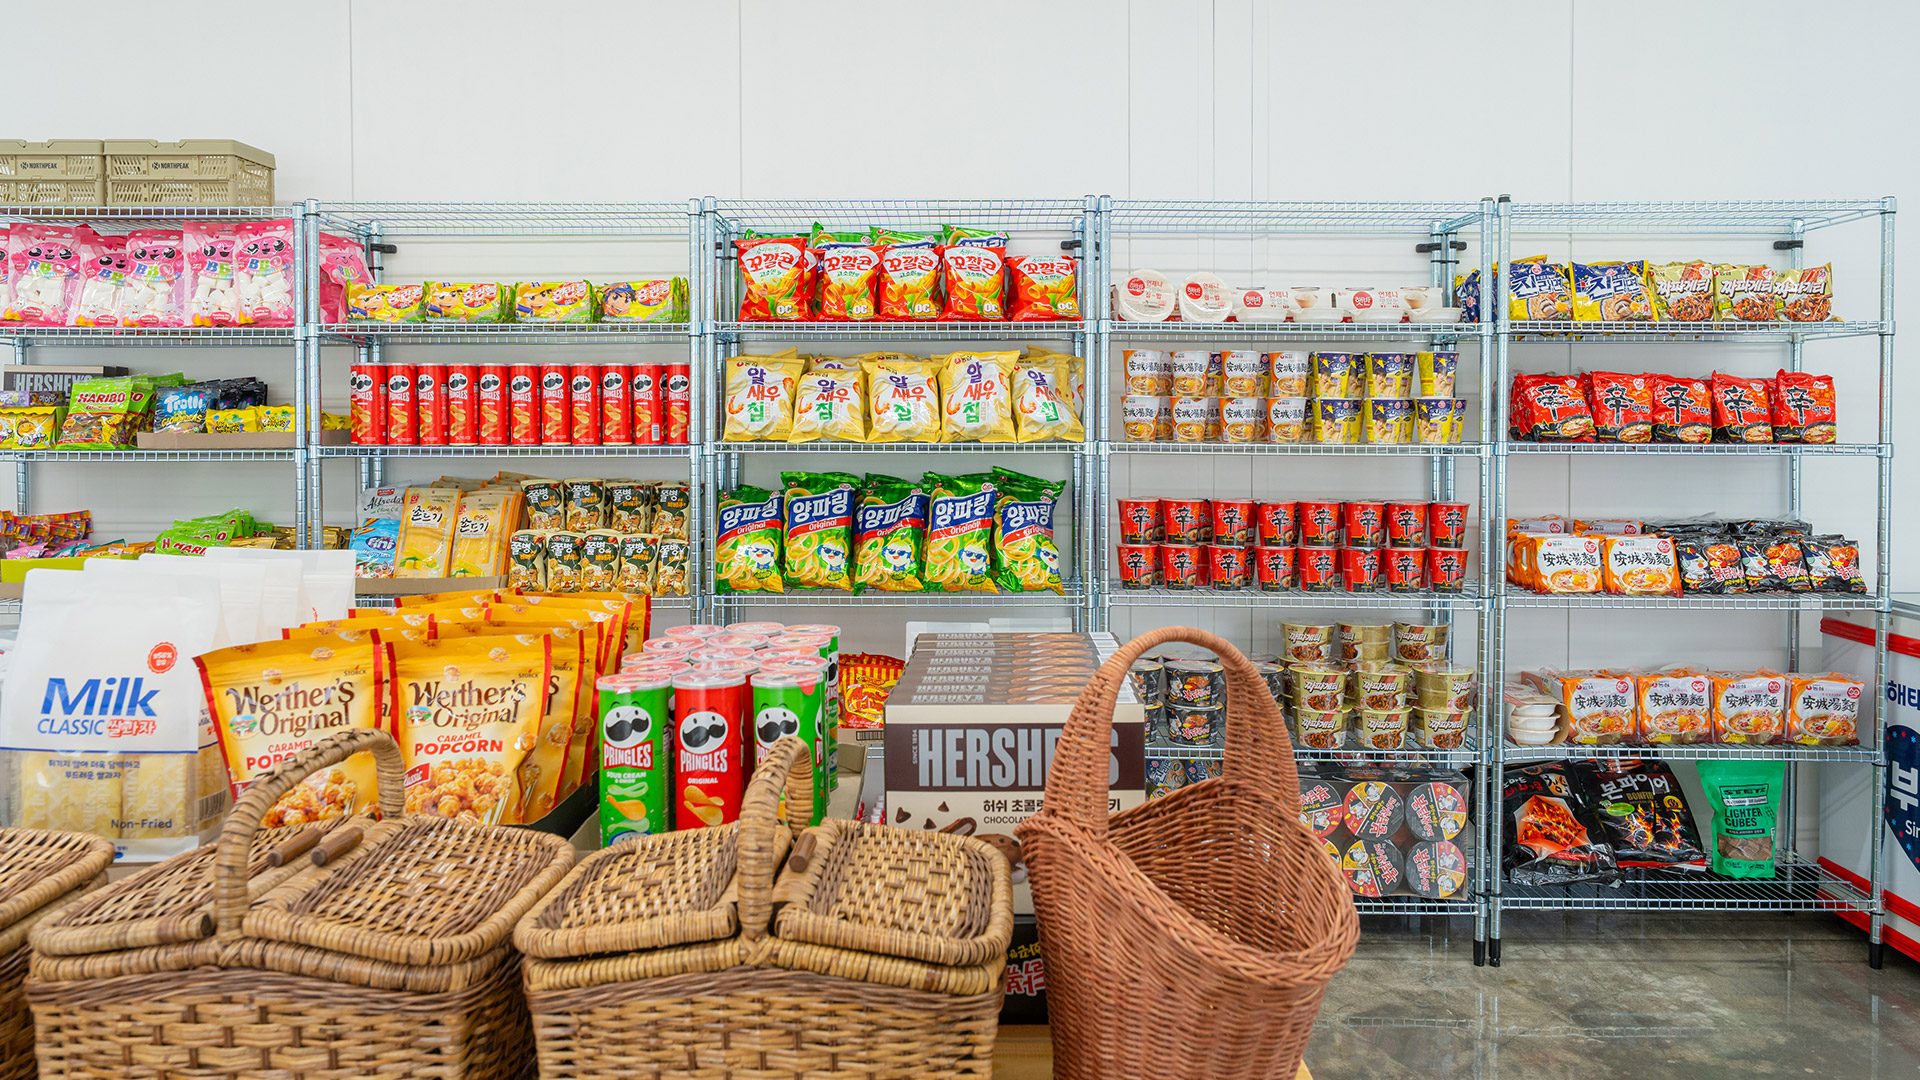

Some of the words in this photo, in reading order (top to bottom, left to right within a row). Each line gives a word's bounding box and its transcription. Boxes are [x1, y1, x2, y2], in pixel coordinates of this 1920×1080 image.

[745, 251, 795, 272] 꼬깔콘
[825, 255, 873, 272] 꼬깔콘
[884, 255, 934, 272] 꼬깔콘
[949, 255, 999, 276] 꼬깔콘
[1023, 261, 1071, 276] 꼬깔콘
[1511, 275, 1563, 299] 진라면
[1586, 275, 1641, 302] 진라면
[1656, 279, 1711, 299] 짜파게티
[1720, 279, 1774, 299] 짜파게티
[1774, 280, 1827, 299] 짜파게티
[1245, 295, 1262, 305] 햇반
[1354, 296, 1371, 306] 햇반
[747, 367, 767, 385] 알
[889, 375, 908, 389] 알
[966, 362, 983, 384] 알
[1027, 370, 1048, 386] 알
[746, 384, 780, 402] 새우
[815, 388, 850, 403] 새우
[817, 379, 837, 393] 알
[891, 386, 927, 402] 새우
[963, 380, 997, 401] 새우
[77, 391, 126, 404] HARIBO
[164, 393, 203, 413] Trolli
[1536, 382, 1570, 421] 辛
[1603, 383, 1635, 425] 辛
[1662, 383, 1695, 424] 辛
[1723, 384, 1754, 425] 辛
[1786, 385, 1816, 425] 辛
[747, 401, 764, 422] 칩
[815, 402, 833, 421] 칩
[894, 402, 912, 421] 칩
[963, 401, 980, 423] 칩
[722, 498, 778, 529] 양파링
[792, 491, 848, 523] 양파링
[865, 496, 918, 529] 양파링
[935, 494, 991, 527] 양파링
[1007, 504, 1051, 528] 양파링
[737, 521, 766, 534] Original
[809, 519, 837, 531] Original
[950, 520, 980, 534] Original
[1132, 506, 1151, 534] 辛
[1175, 506, 1194, 534] 辛
[1222, 507, 1242, 534] 辛
[1271, 508, 1290, 536] 辛
[1313, 508, 1333, 535] 辛
[1359, 508, 1379, 536] 辛
[1397, 509, 1418, 537] 辛
[1444, 510, 1464, 537] 辛
[367, 536, 395, 551] Fini
[1127, 552, 1147, 579] 辛
[1173, 552, 1193, 579] 辛
[1267, 553, 1287, 581] 辛
[1396, 555, 1417, 582] 辛
[1440, 555, 1461, 582] 辛
[1542, 552, 1597, 567] 安城湯麵
[1614, 552, 1671, 567] 安城湯麵
[40, 677, 161, 717] Milk
[226, 678, 355, 715] Werther's
[408, 680, 527, 707] Werther's
[1575, 693, 1628, 710] 安城湯麵
[1650, 693, 1705, 707] 安城湯麵
[1725, 694, 1778, 709] 安城湯麵
[1802, 695, 1856, 713] 安城湯麵
[259, 702, 351, 738] Original
[433, 700, 519, 731] Original
[37, 718, 105, 736] CLASSIC
[106, 719, 157, 738] 쌀과자
[437, 732, 482, 743] CARAMEL
[414, 740, 503, 756] POPCORN
[603, 743, 652, 768] PRINGLES
[680, 749, 728, 773] PRINGLES
[1601, 773, 1670, 800] 본파이어
[983, 800, 1008, 812] 허쉬
[1724, 807, 1763, 818] LIGHTER
[111, 819, 173, 830] Non-Fried
[983, 816, 1031, 824] CHOCOLAT
[1724, 817, 1758, 828] CUBES
